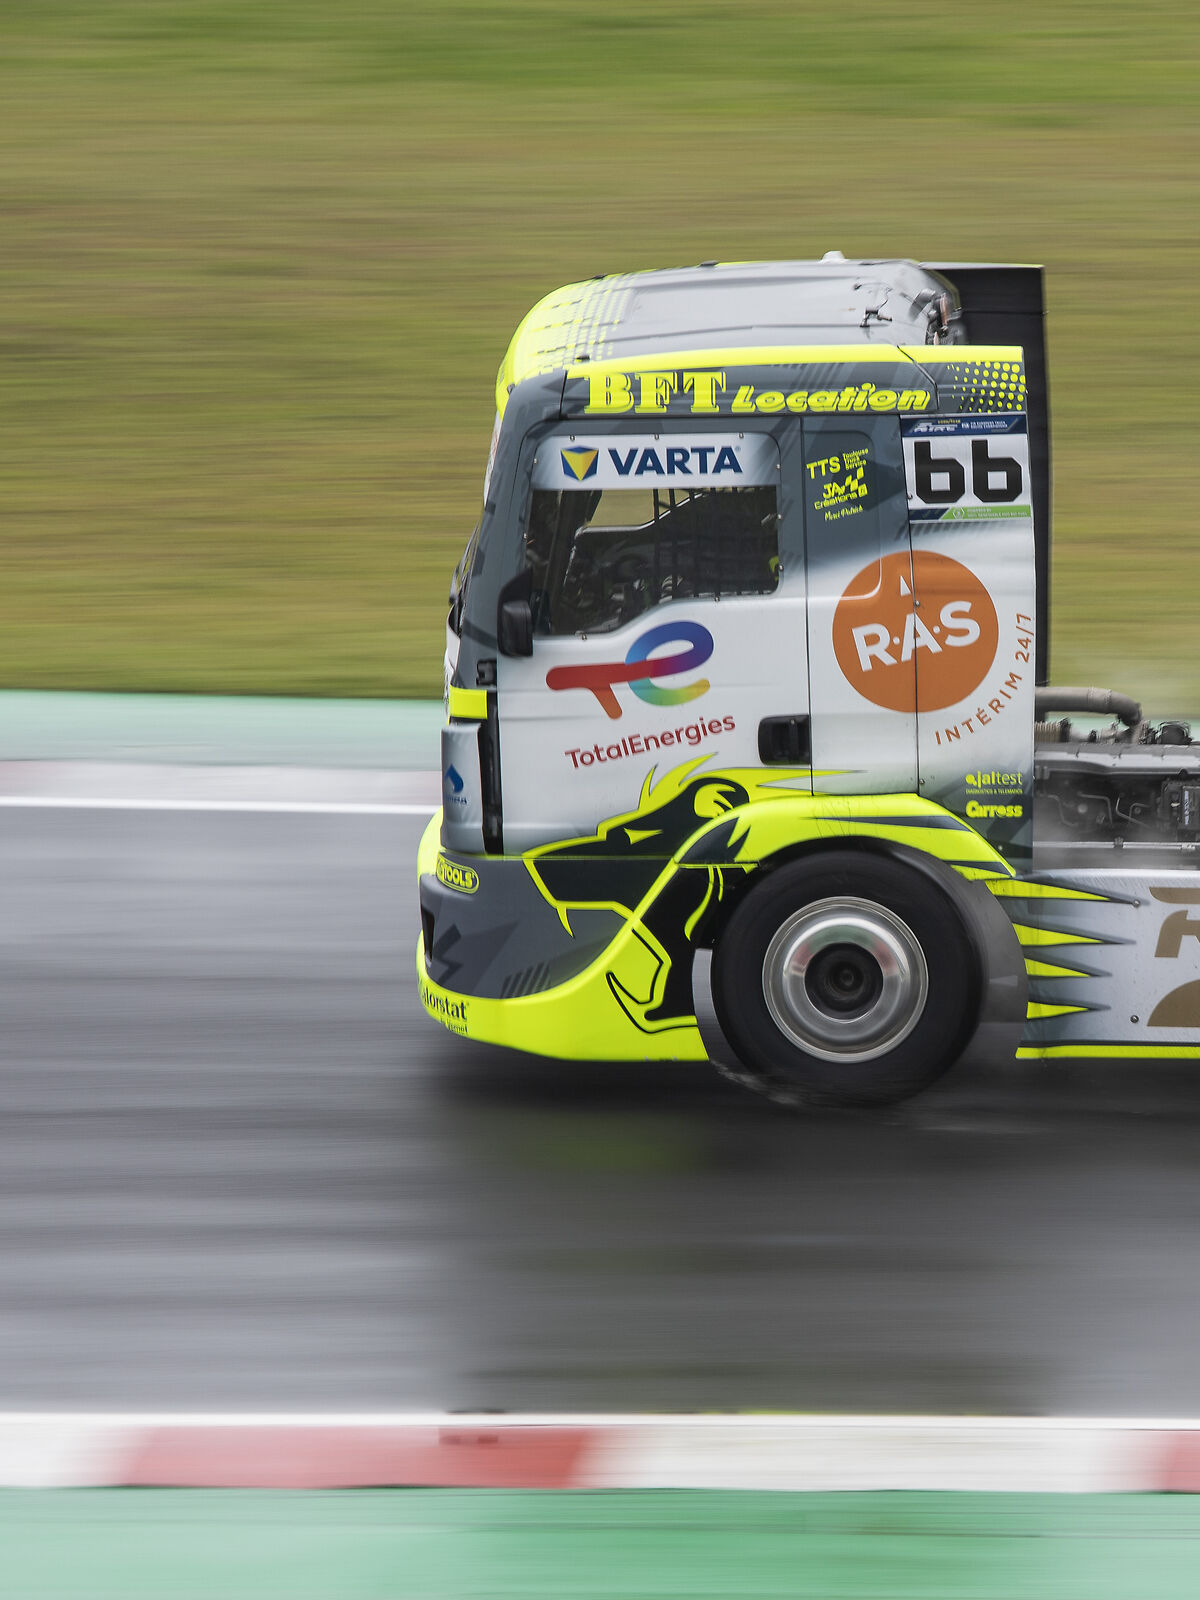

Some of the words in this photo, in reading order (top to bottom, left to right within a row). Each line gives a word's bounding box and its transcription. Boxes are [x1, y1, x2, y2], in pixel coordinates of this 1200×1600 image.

[584, 371, 726, 414] BFT
[731, 383, 931, 412] Location
[608, 446, 743, 475] VARTA
[806, 456, 841, 479] TTS
[914, 439, 1023, 504] 66
[935, 671, 1023, 746] INTÉRIM
[1015, 612, 1034, 663] 24/7
[565, 715, 736, 769] TotalEnergies
